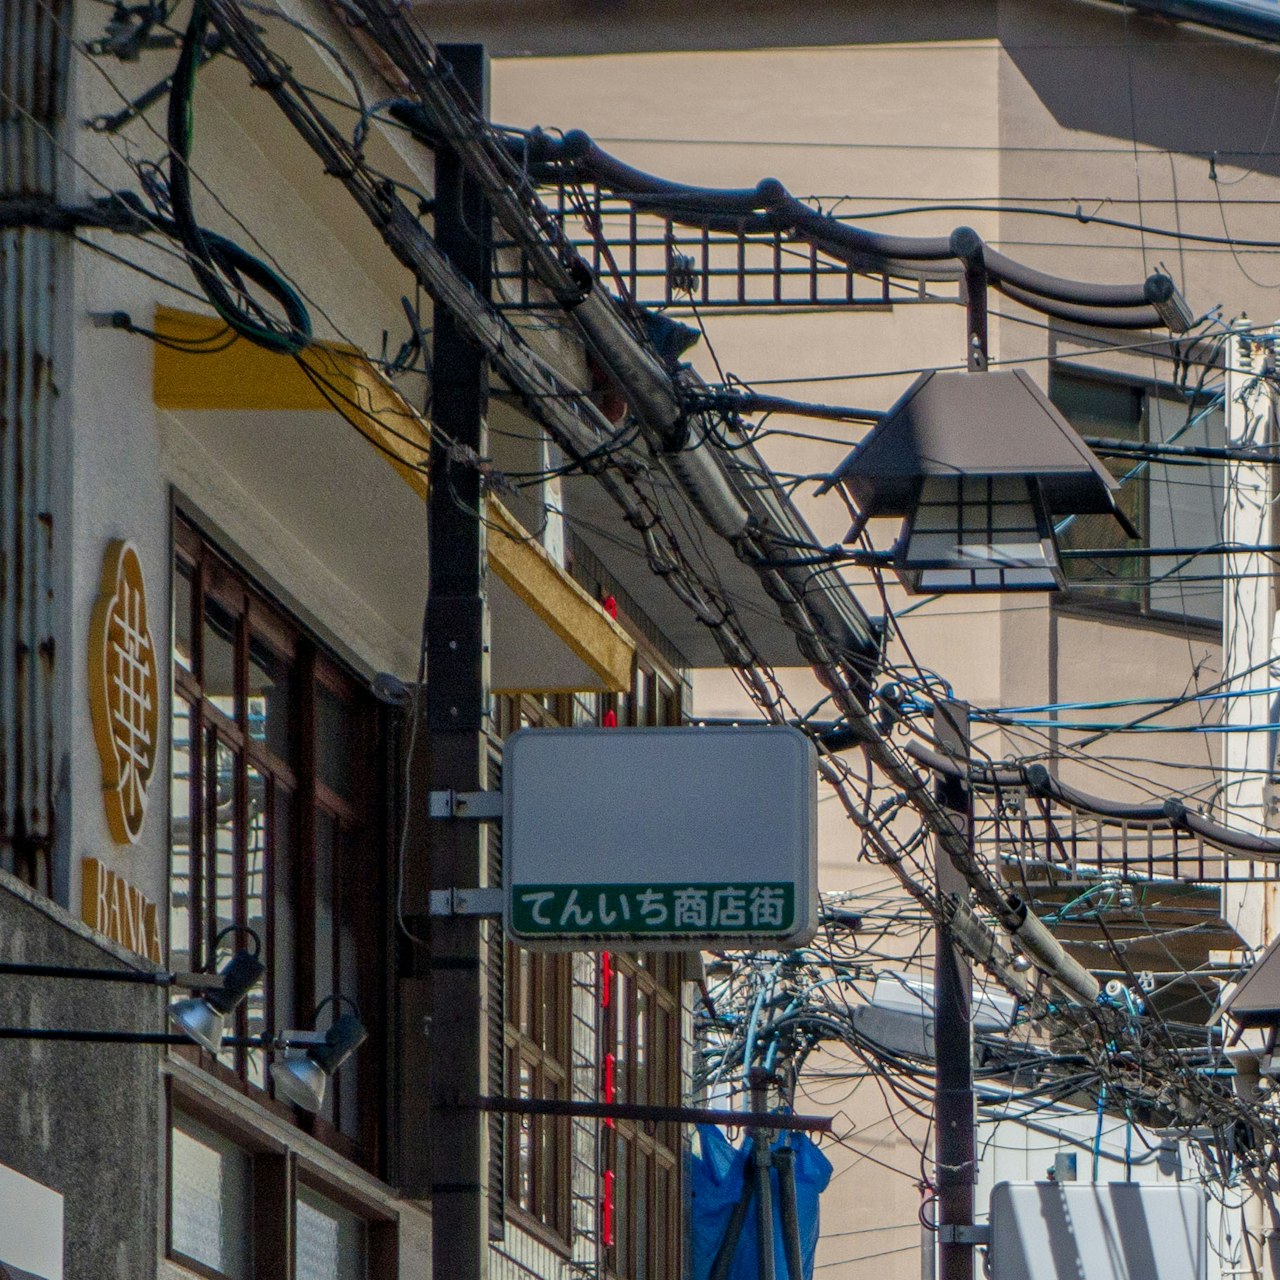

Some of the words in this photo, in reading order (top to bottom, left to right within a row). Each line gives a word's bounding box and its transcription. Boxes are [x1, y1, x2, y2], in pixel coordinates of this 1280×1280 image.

[97, 878, 163, 965] BANKA
[521, 887, 786, 929] てんいち商店街
